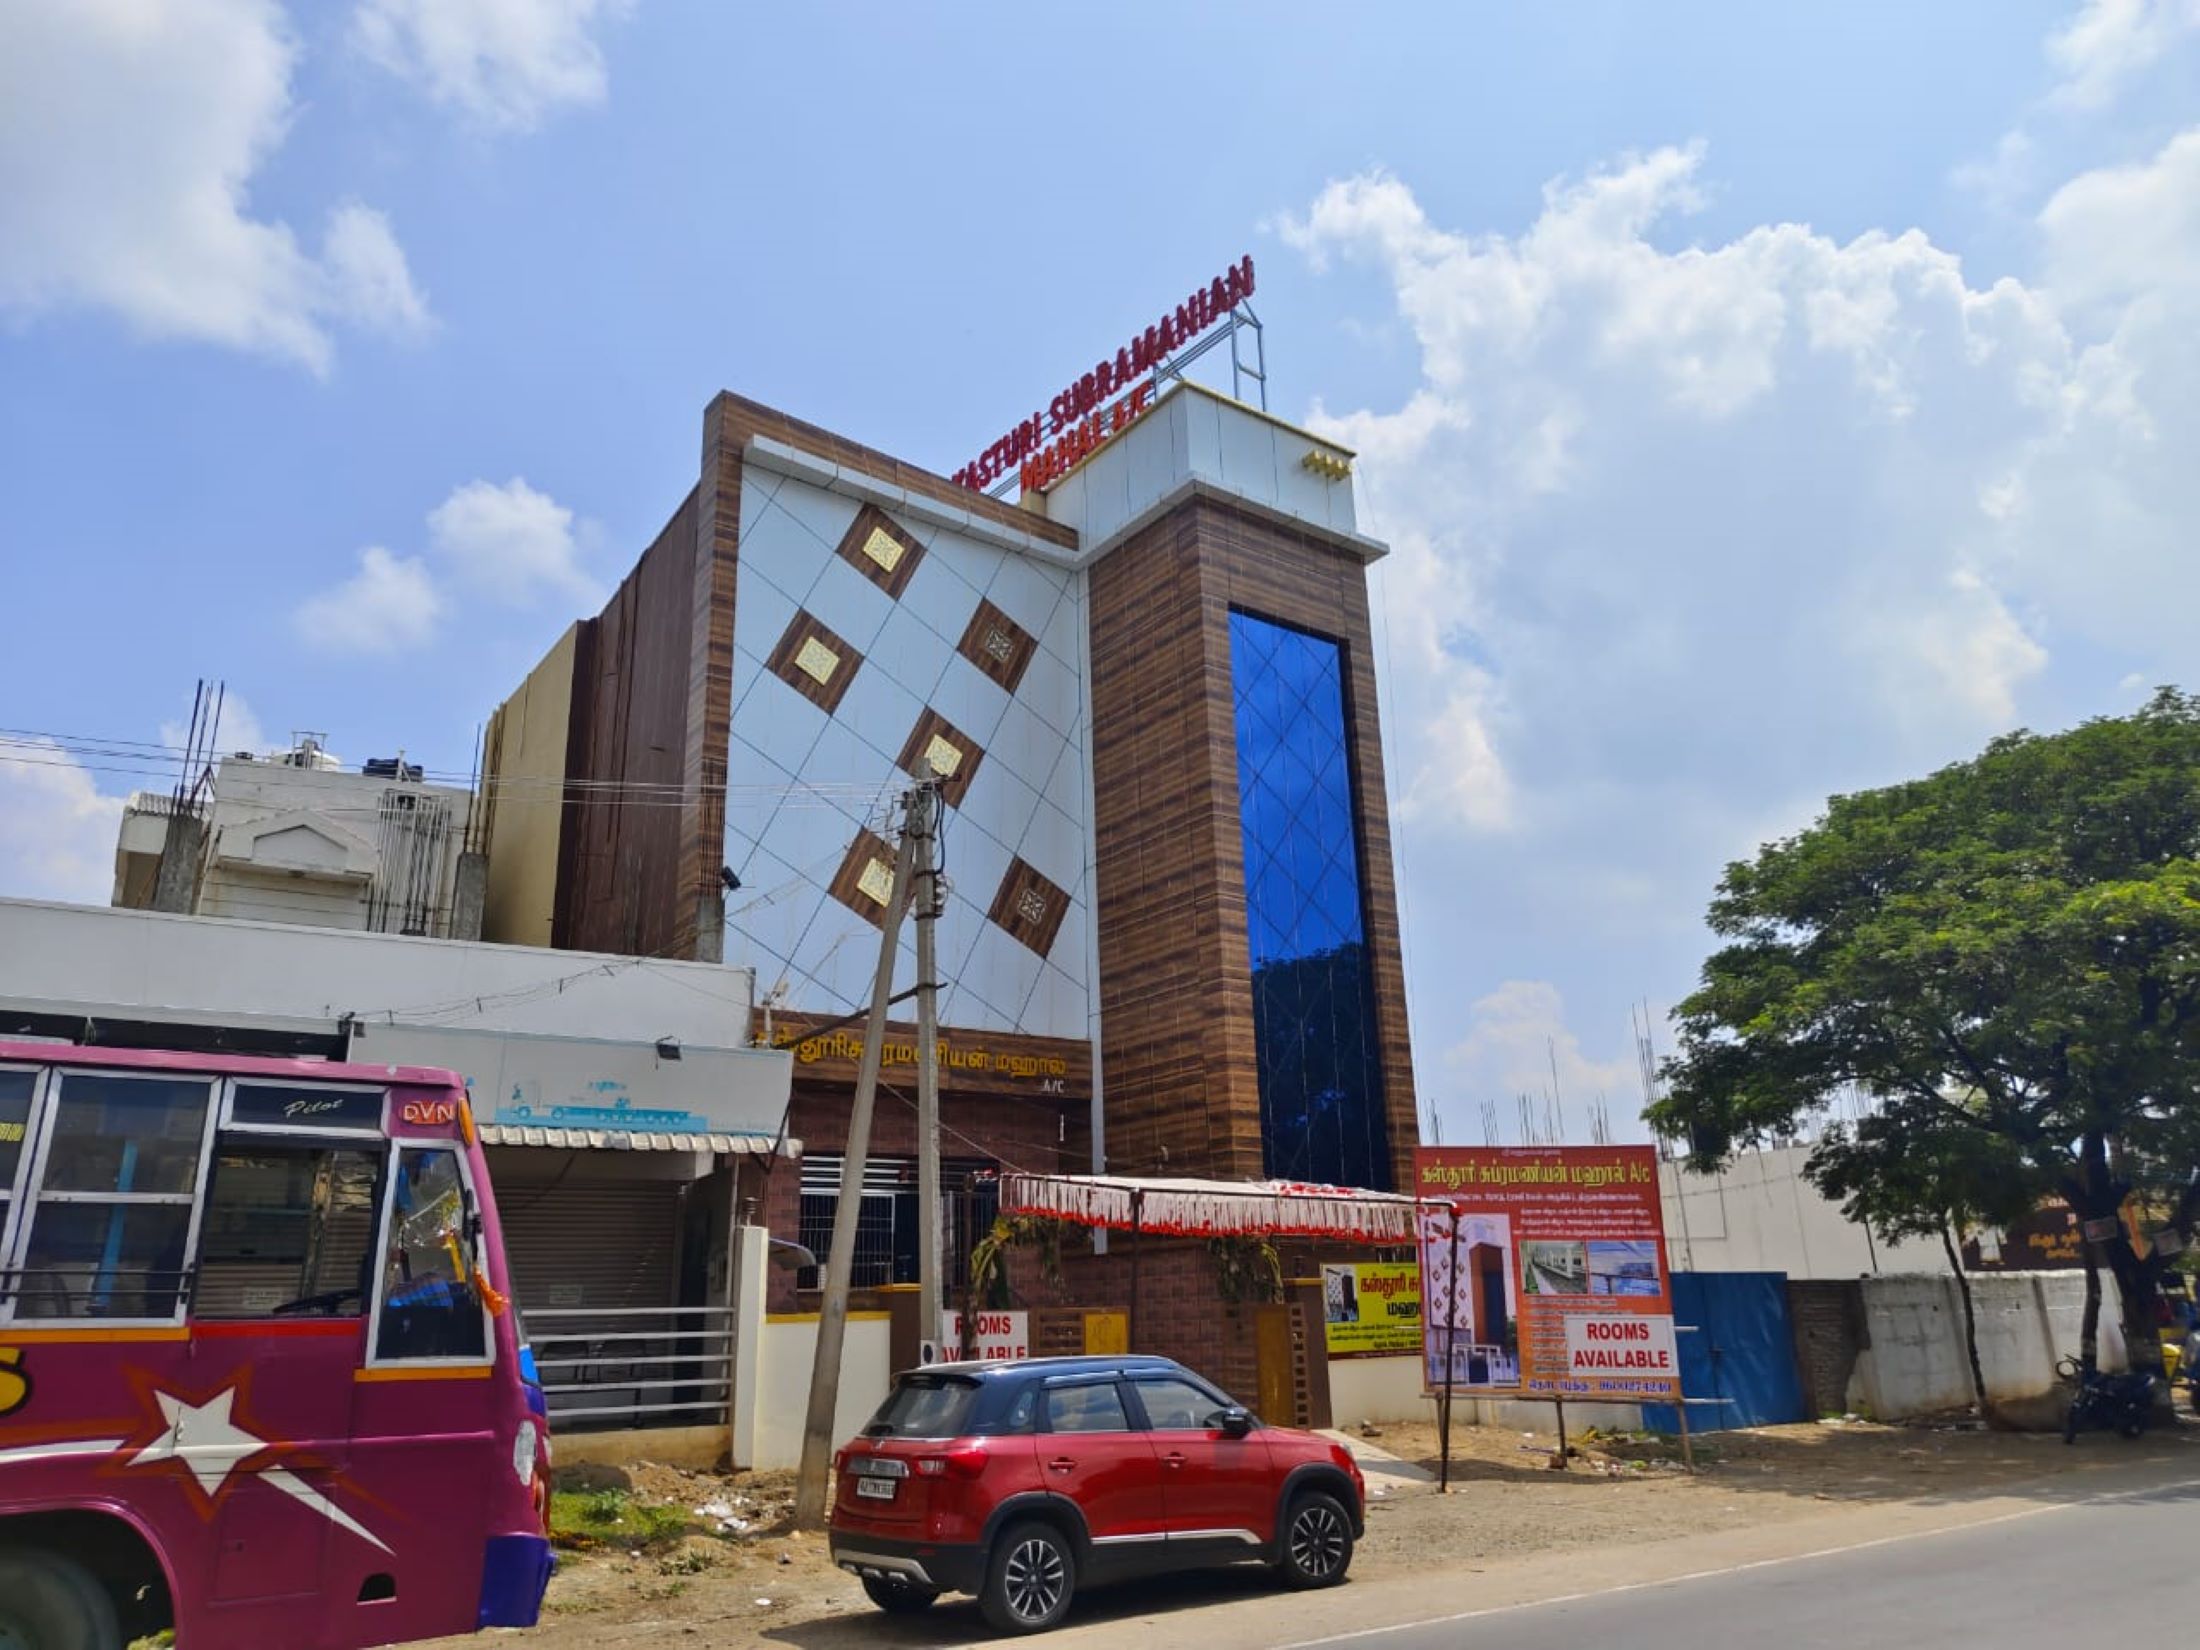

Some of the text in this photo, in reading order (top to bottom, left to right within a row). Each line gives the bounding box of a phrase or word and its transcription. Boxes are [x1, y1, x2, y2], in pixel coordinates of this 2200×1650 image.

[284, 1099, 344, 1118] Pilot
[403, 1103, 454, 1121] DVN
[954, 1315, 1012, 1336] ROMS
[1586, 1322, 1650, 1341] ROOMS
[1573, 1350, 1670, 1369] AVAILABLE
